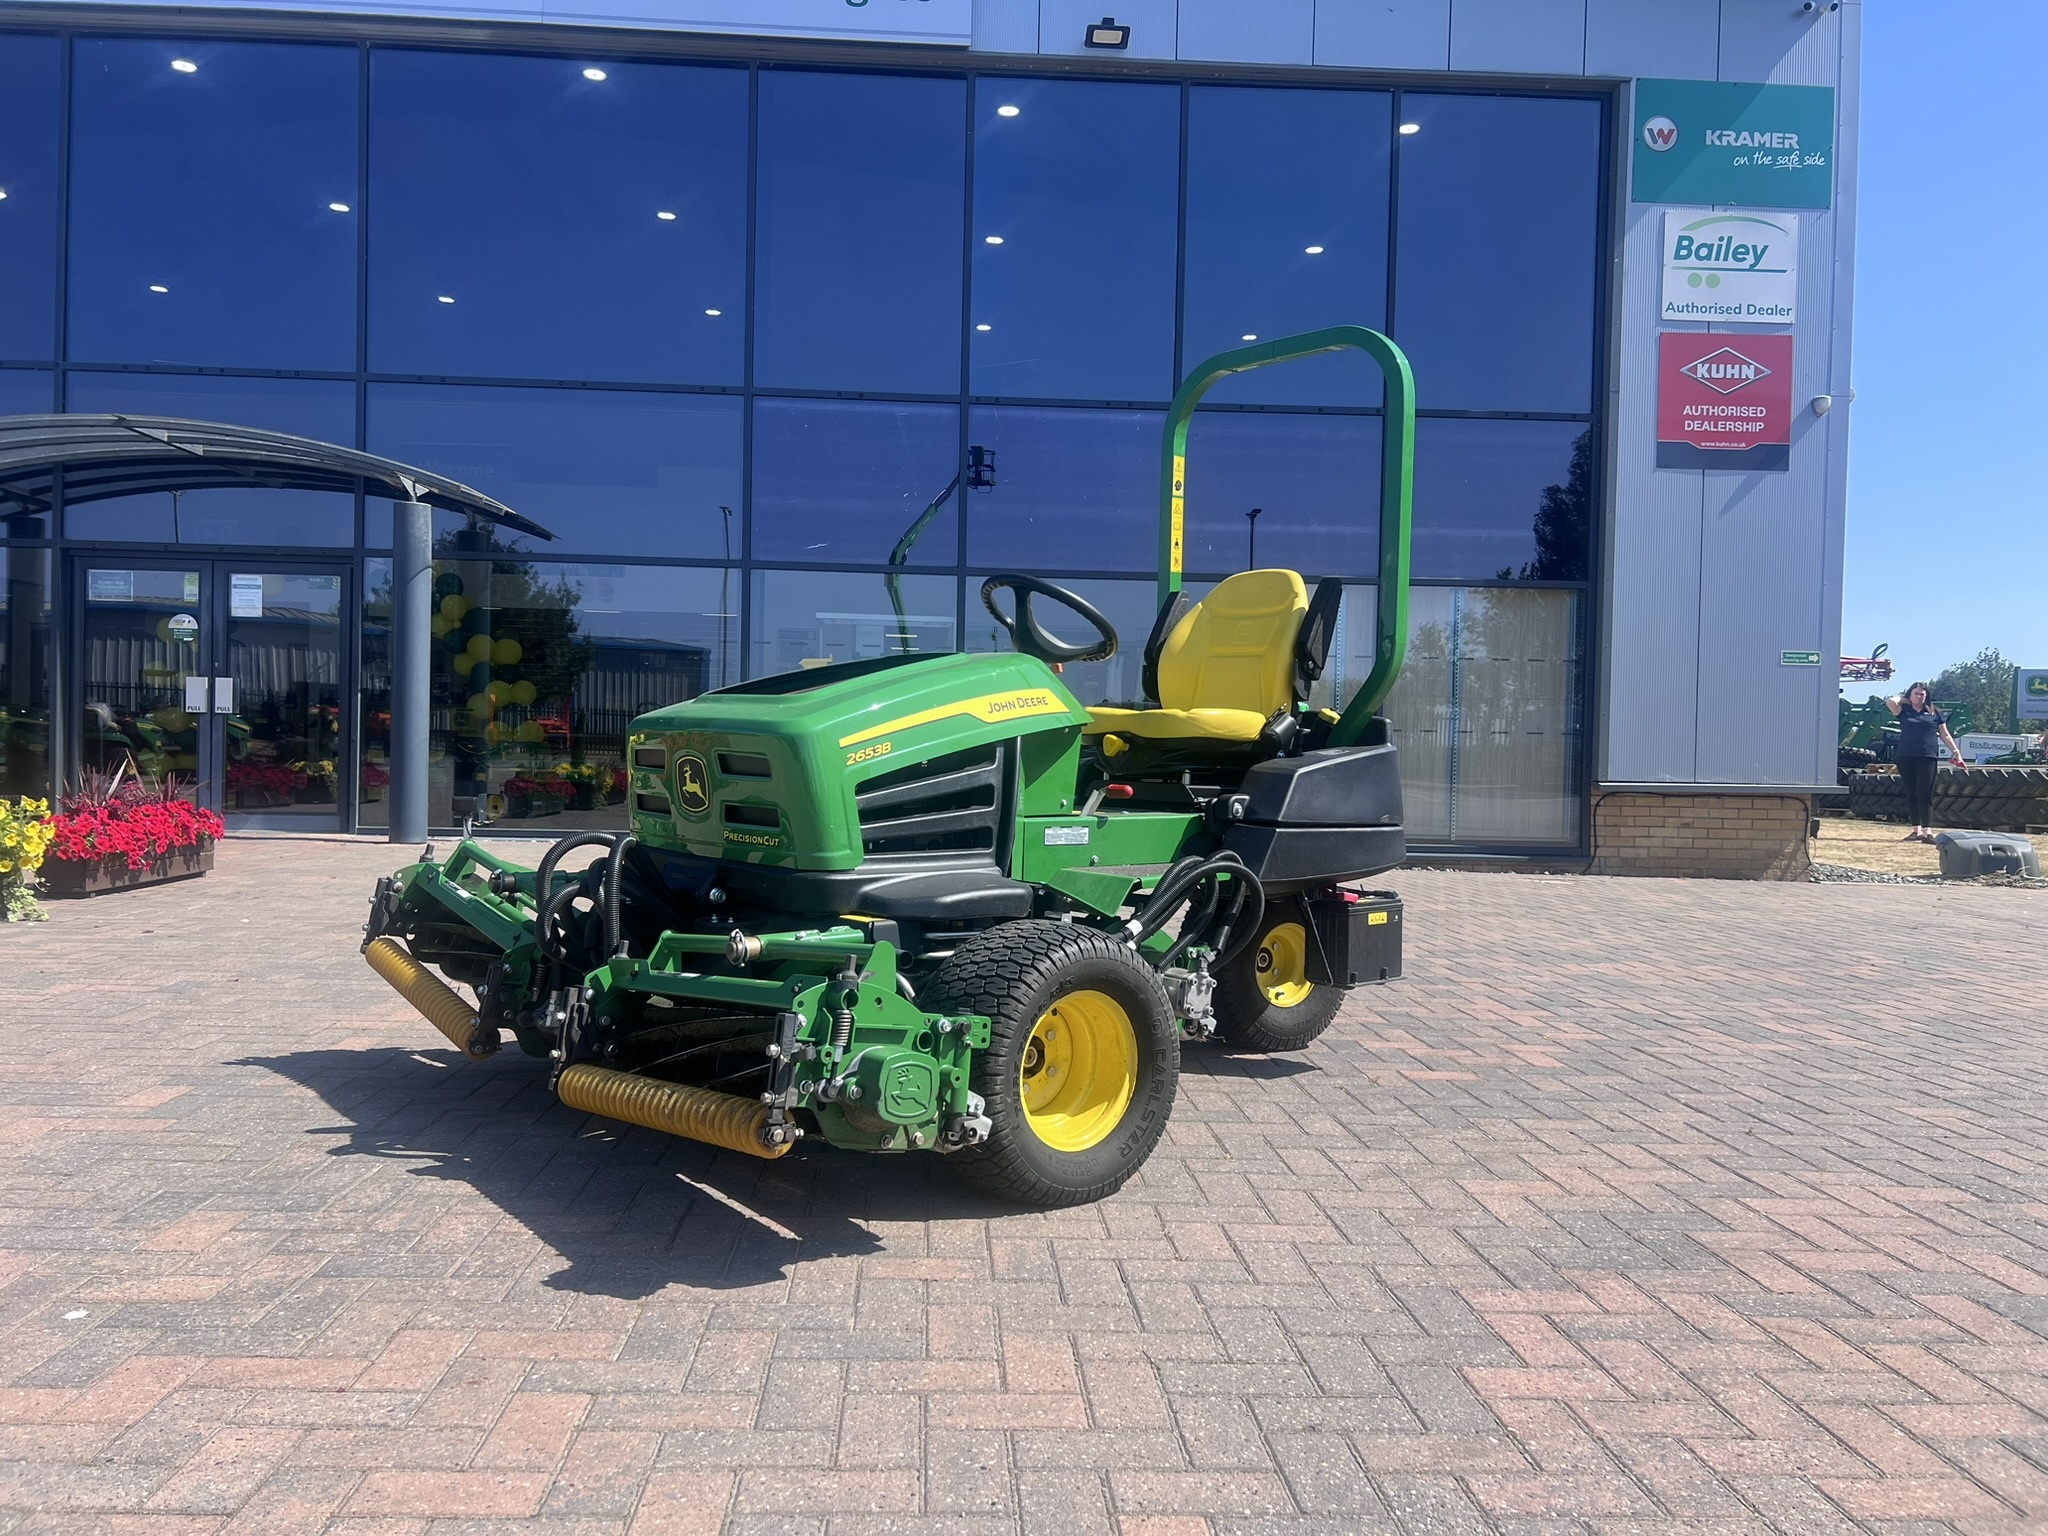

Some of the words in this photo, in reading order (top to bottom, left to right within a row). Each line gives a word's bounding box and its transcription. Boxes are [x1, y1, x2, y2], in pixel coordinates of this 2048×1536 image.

[1705, 129, 1800, 149] KRAMER
[1733, 155, 1750, 166] on
[1753, 150, 1773, 165] the
[1774, 150, 1801, 171] safe
[1802, 151, 1826, 166] side
[1673, 234, 1770, 270] Bailey
[1664, 301, 1742, 315] Authorised
[1746, 303, 1793, 317] Dealer
[1696, 363, 1756, 379] KUHN
[1682, 404, 1767, 417] AUTHORISED
[1684, 420, 1765, 432] DEALERSHIP
[987, 698, 1017, 714] JOHN
[1018, 696, 1049, 708] DEERE
[844, 741, 893, 766] 2653B
[1120, 1048, 1168, 1160] CARLSTAR
